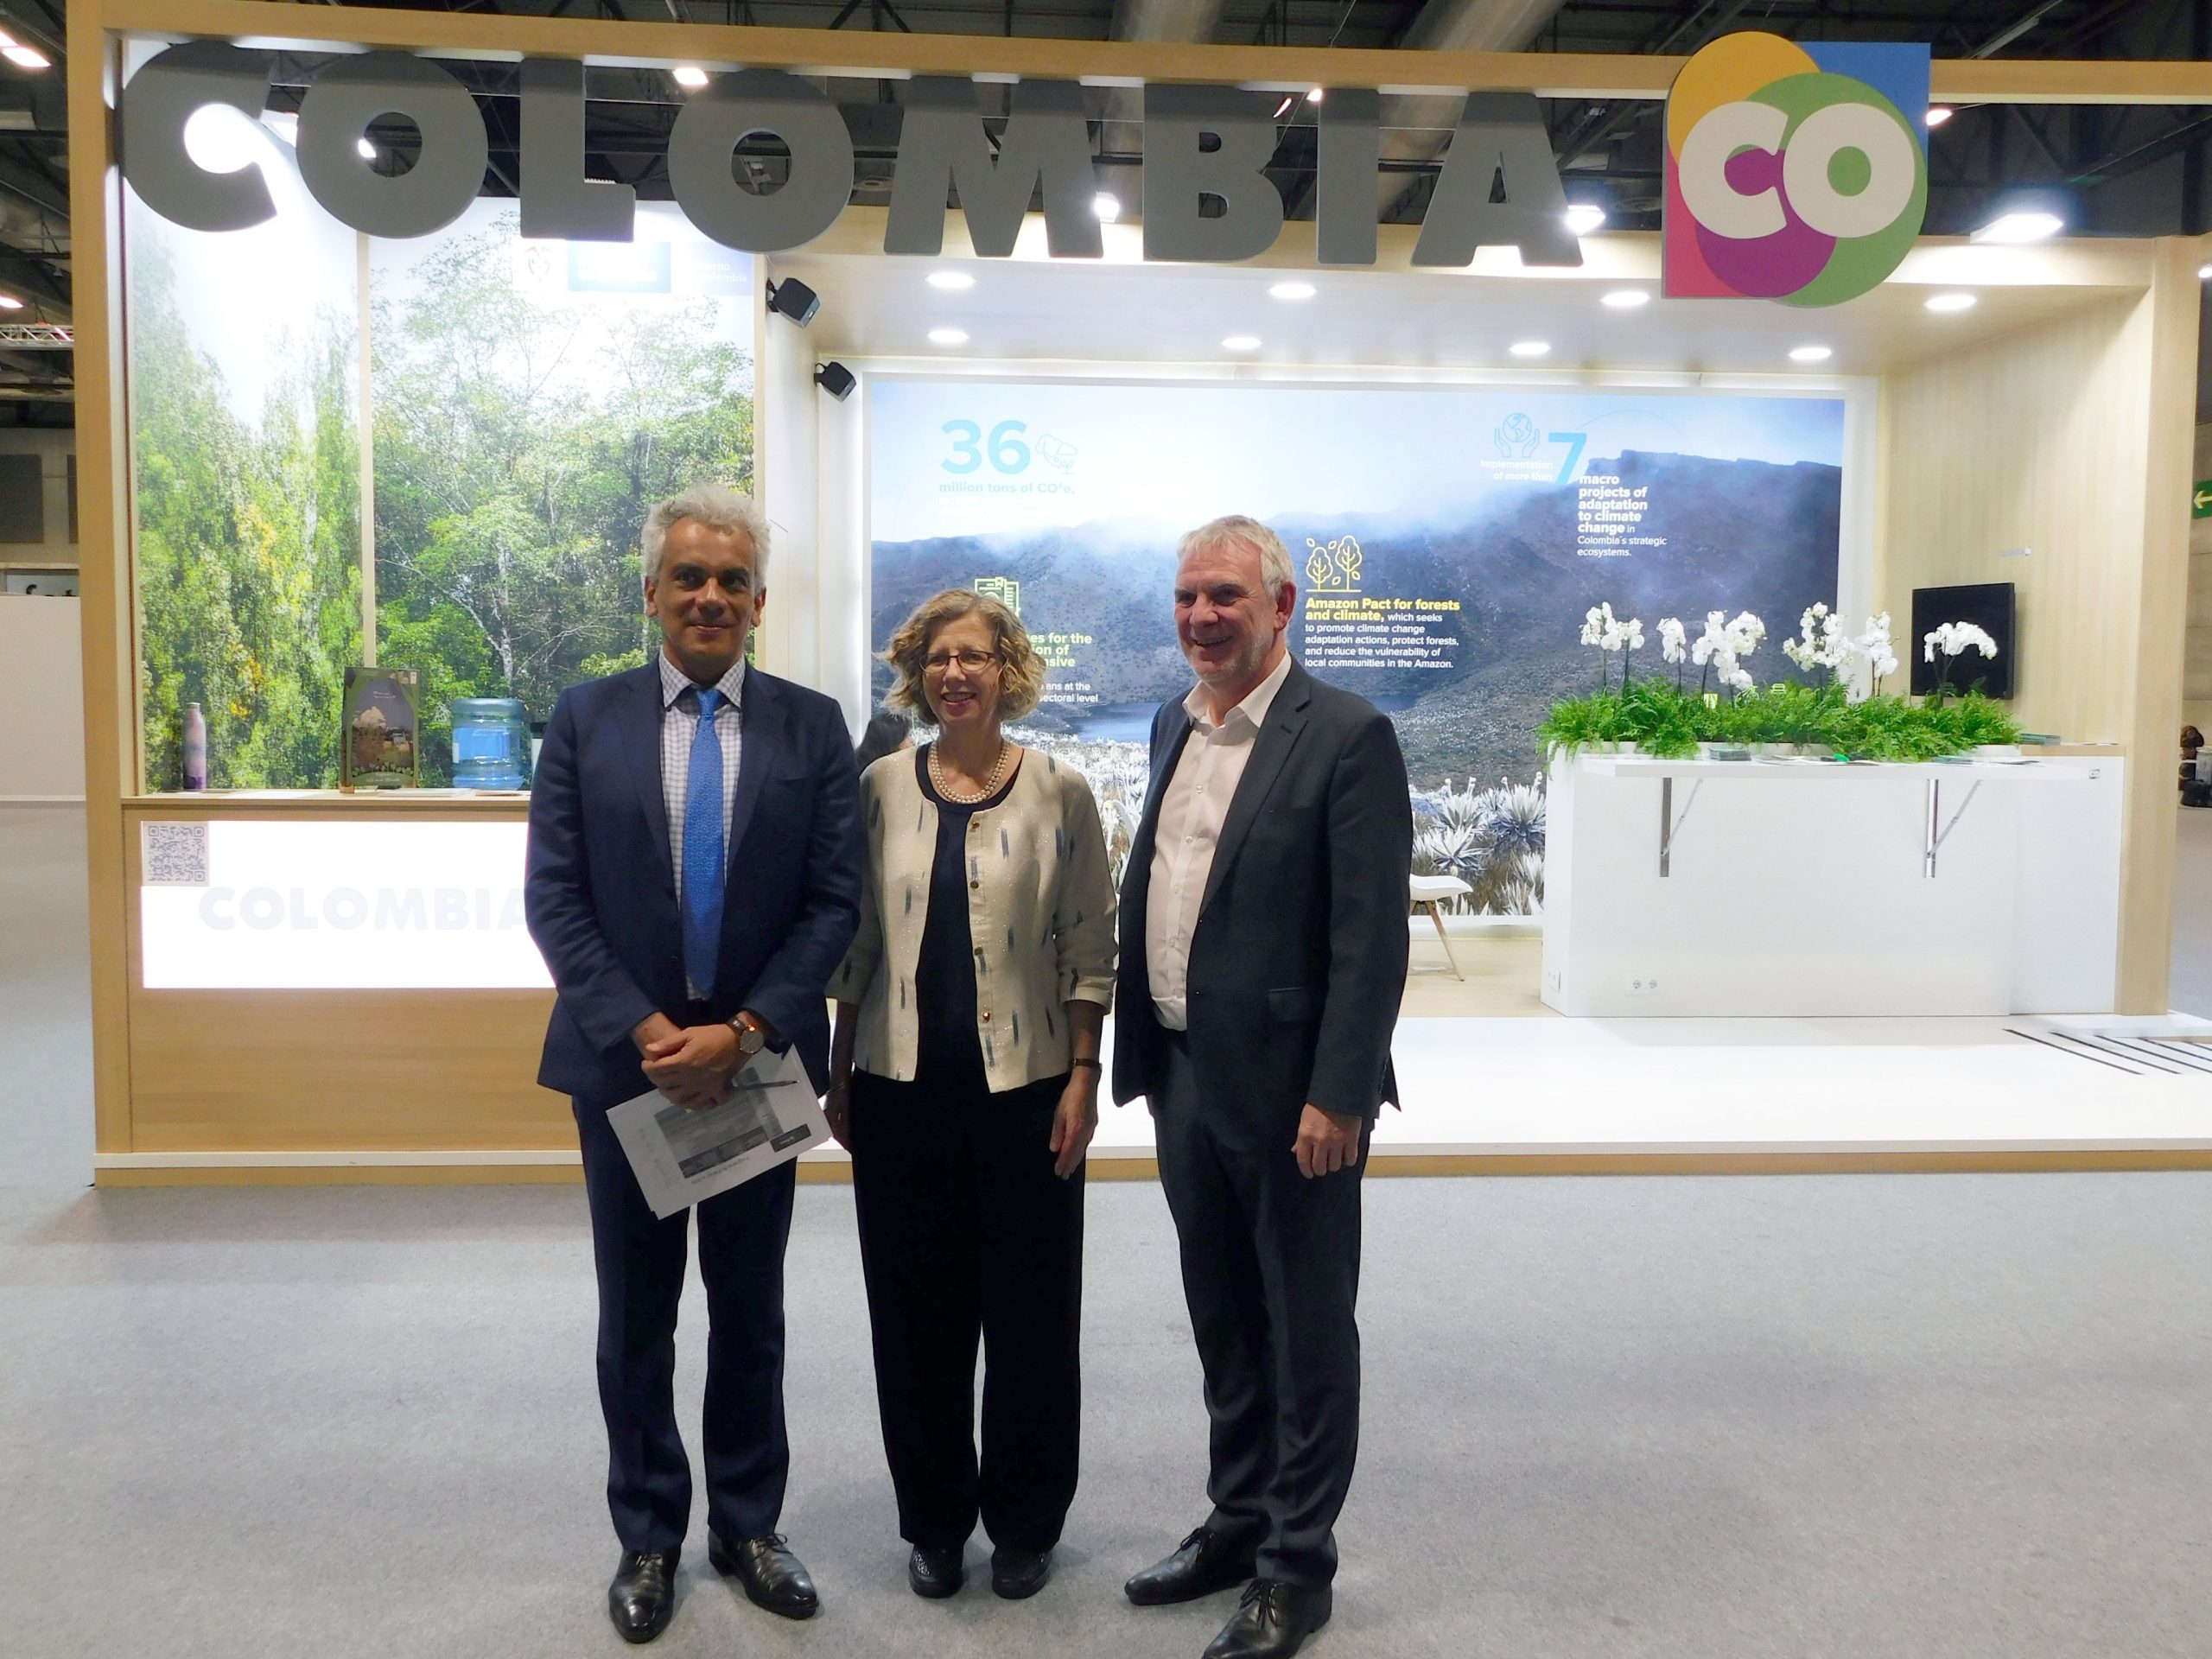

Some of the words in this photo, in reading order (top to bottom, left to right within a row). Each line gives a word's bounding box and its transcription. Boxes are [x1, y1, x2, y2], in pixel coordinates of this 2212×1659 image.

[116, 41, 1584, 267] COLOMBIA
[1678, 100, 1916, 239] CO
[941, 419, 1031, 474] 36
[1480, 459, 1554, 470] Implementation
[1548, 432, 1587, 485] 7
[1493, 472, 1503, 480] of
[1531, 473, 1553, 481] than
[1579, 475, 1620, 485] macro
[939, 481, 983, 493] million
[988, 483, 1016, 493] tons
[1020, 482, 1034, 493] of
[1579, 486, 1630, 499] projects
[1633, 486, 1648, 498] of
[1578, 499, 1648, 512] adaptation
[1578, 511, 1592, 521] to
[1594, 509, 1642, 522] climate
[1578, 522, 1625, 536] change
[1626, 524, 1635, 533] in
[1628, 537, 1668, 547] strategic
[1577, 548, 1632, 557] ecosystems.
[1305, 597, 1359, 609] Amazon
[1362, 597, 1391, 610] Pact
[1394, 598, 1413, 610] for
[1414, 598, 1460, 611] forests
[1305, 608, 1331, 620] and
[1332, 608, 1385, 623] climate,
[1387, 613, 1414, 622] which
[1415, 613, 1443, 622] seeks
[1305, 623, 1315, 632] to
[1316, 624, 1355, 634] promote
[1357, 623, 1390, 633] climate
[1391, 624, 1426, 635] change
[1048, 632, 1068, 644] for
[1070, 632, 1093, 645] the
[1305, 635, 1353, 645] adaptation
[1355, 635, 1390, 645] actions,
[1392, 636, 1425, 646] protect
[1426, 635, 1459, 646] forests,
[1055, 644, 1071, 656] of
[1305, 646, 1323, 656] and
[1324, 646, 1357, 656] reduce
[1357, 646, 1374, 656] the
[1375, 646, 1430, 658] vulnerability
[1431, 647, 1442, 657] of
[1305, 658, 1326, 667] local
[1328, 658, 1386, 667] communities
[1387, 658, 1396, 667] in
[1397, 658, 1413, 668] the
[1414, 658, 1454, 669] Amazon.
[1064, 683, 1073, 691] at
[1074, 682, 1091, 691] the
[1076, 693, 1099, 703] level
[198, 886, 526, 931] COLOMBIA
